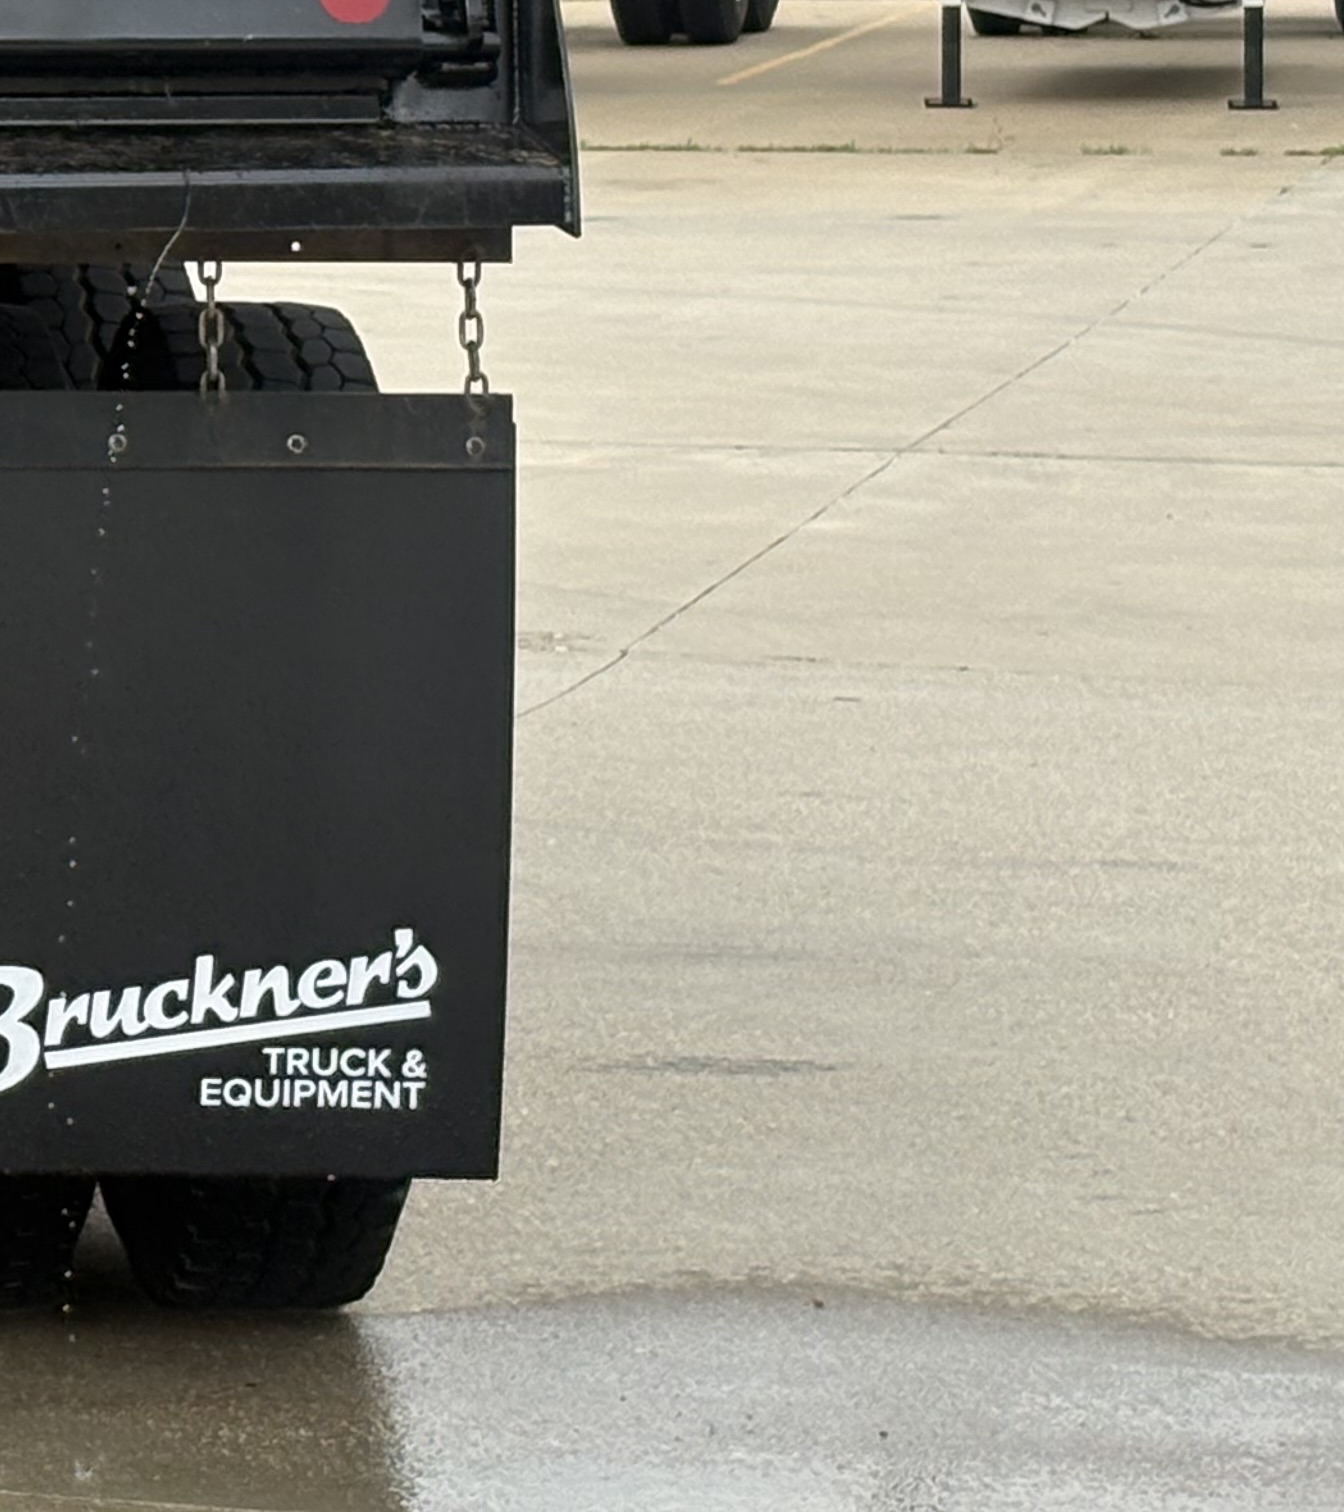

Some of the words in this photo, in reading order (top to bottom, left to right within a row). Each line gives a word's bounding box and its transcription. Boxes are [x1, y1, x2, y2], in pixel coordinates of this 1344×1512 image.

[261, 1047, 392, 1078] TRUCK
[401, 1048, 428, 1079] &
[199, 1078, 427, 1110] EQUIPMENT
